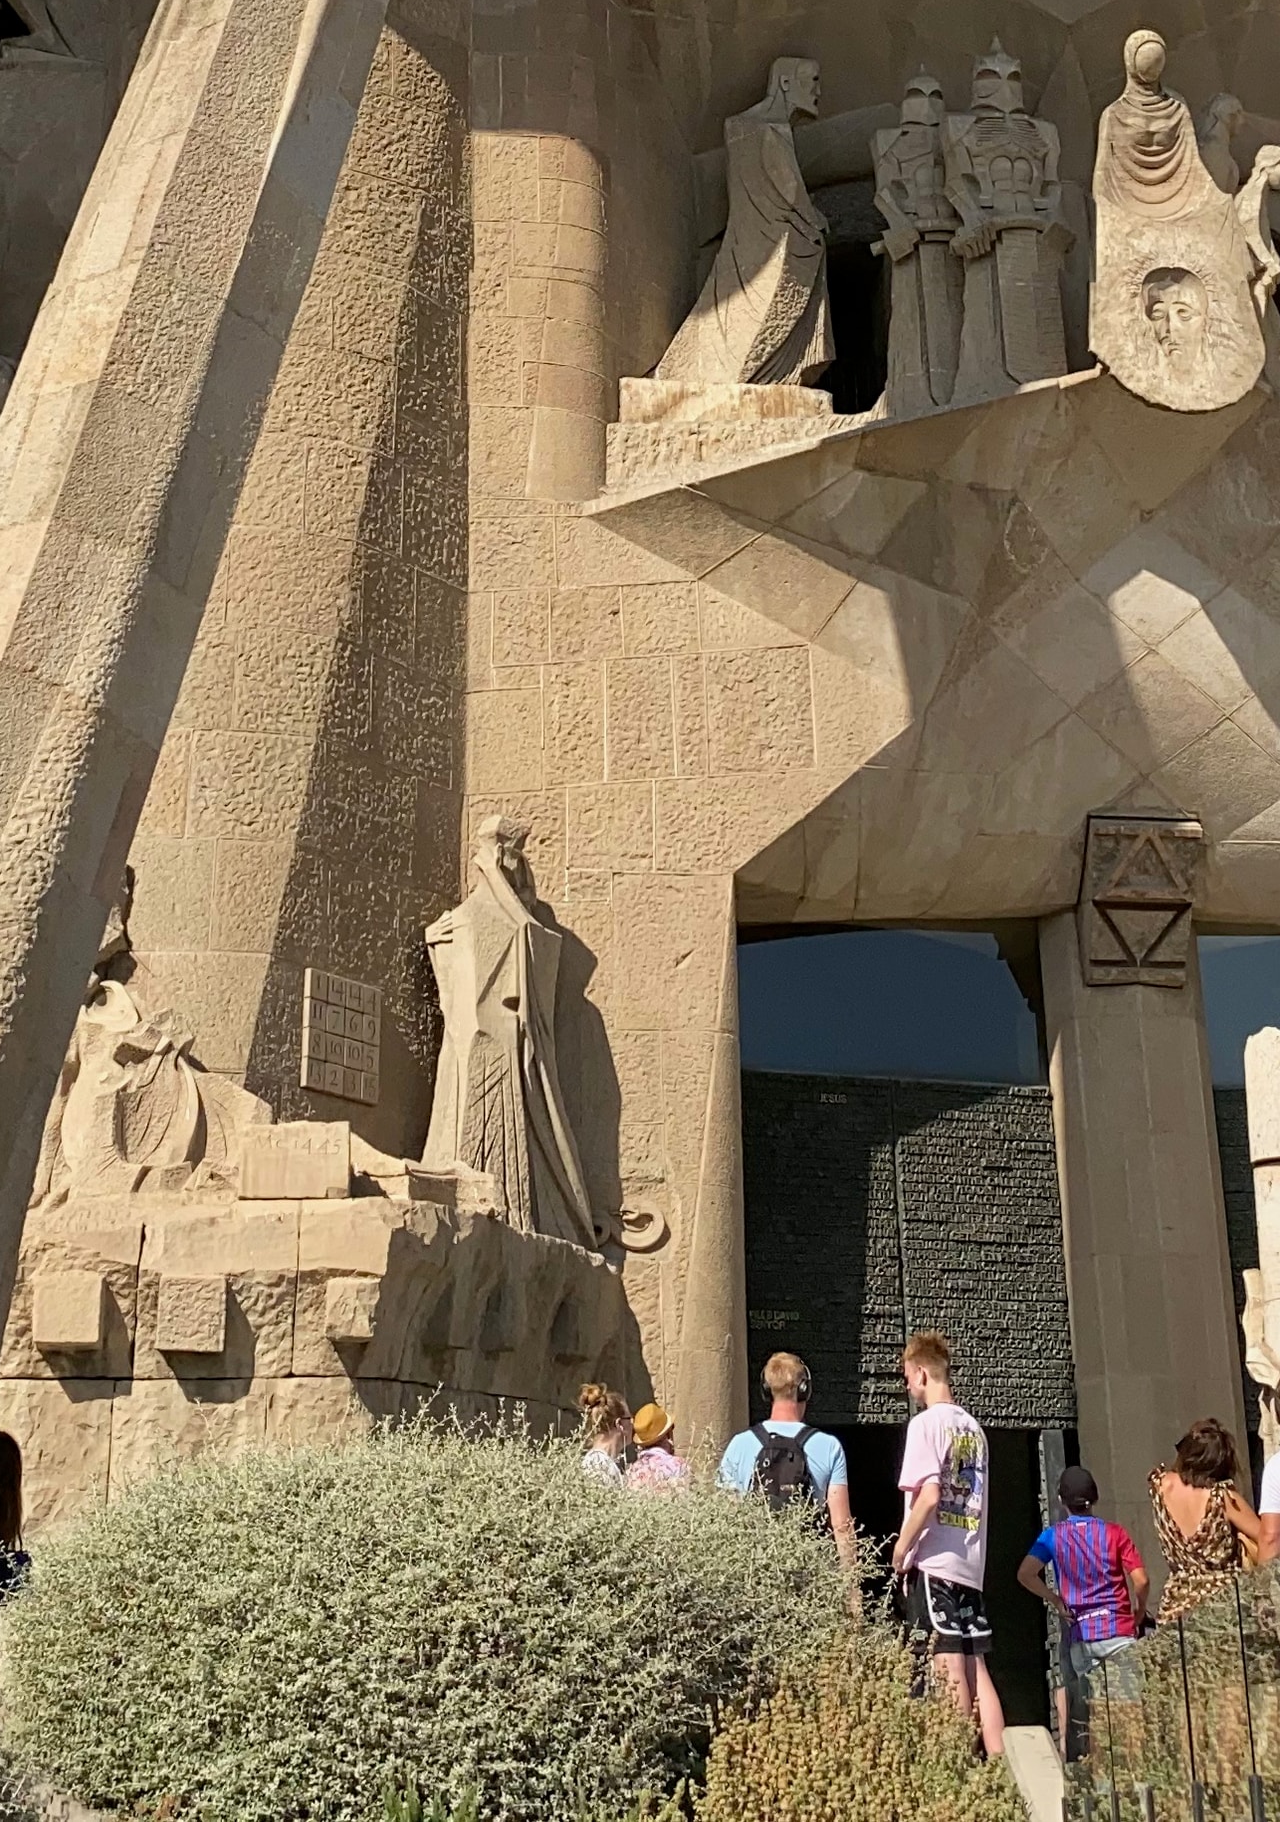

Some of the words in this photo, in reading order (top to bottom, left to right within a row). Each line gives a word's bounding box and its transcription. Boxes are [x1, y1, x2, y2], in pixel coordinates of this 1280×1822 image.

[331, 979, 345, 1003] 14
[349, 984, 362, 1007] 14
[332, 1009, 341, 1029] 7
[349, 1015, 358, 1034] 6
[367, 1020, 376, 1041] 9
[312, 1033, 321, 1054] 8
[330, 1040, 343, 1056] 10
[347, 1046, 361, 1061] 10
[367, 1049, 375, 1070] 5
[330, 1069, 339, 1087] 2
[351, 1074, 357, 1094] 3
